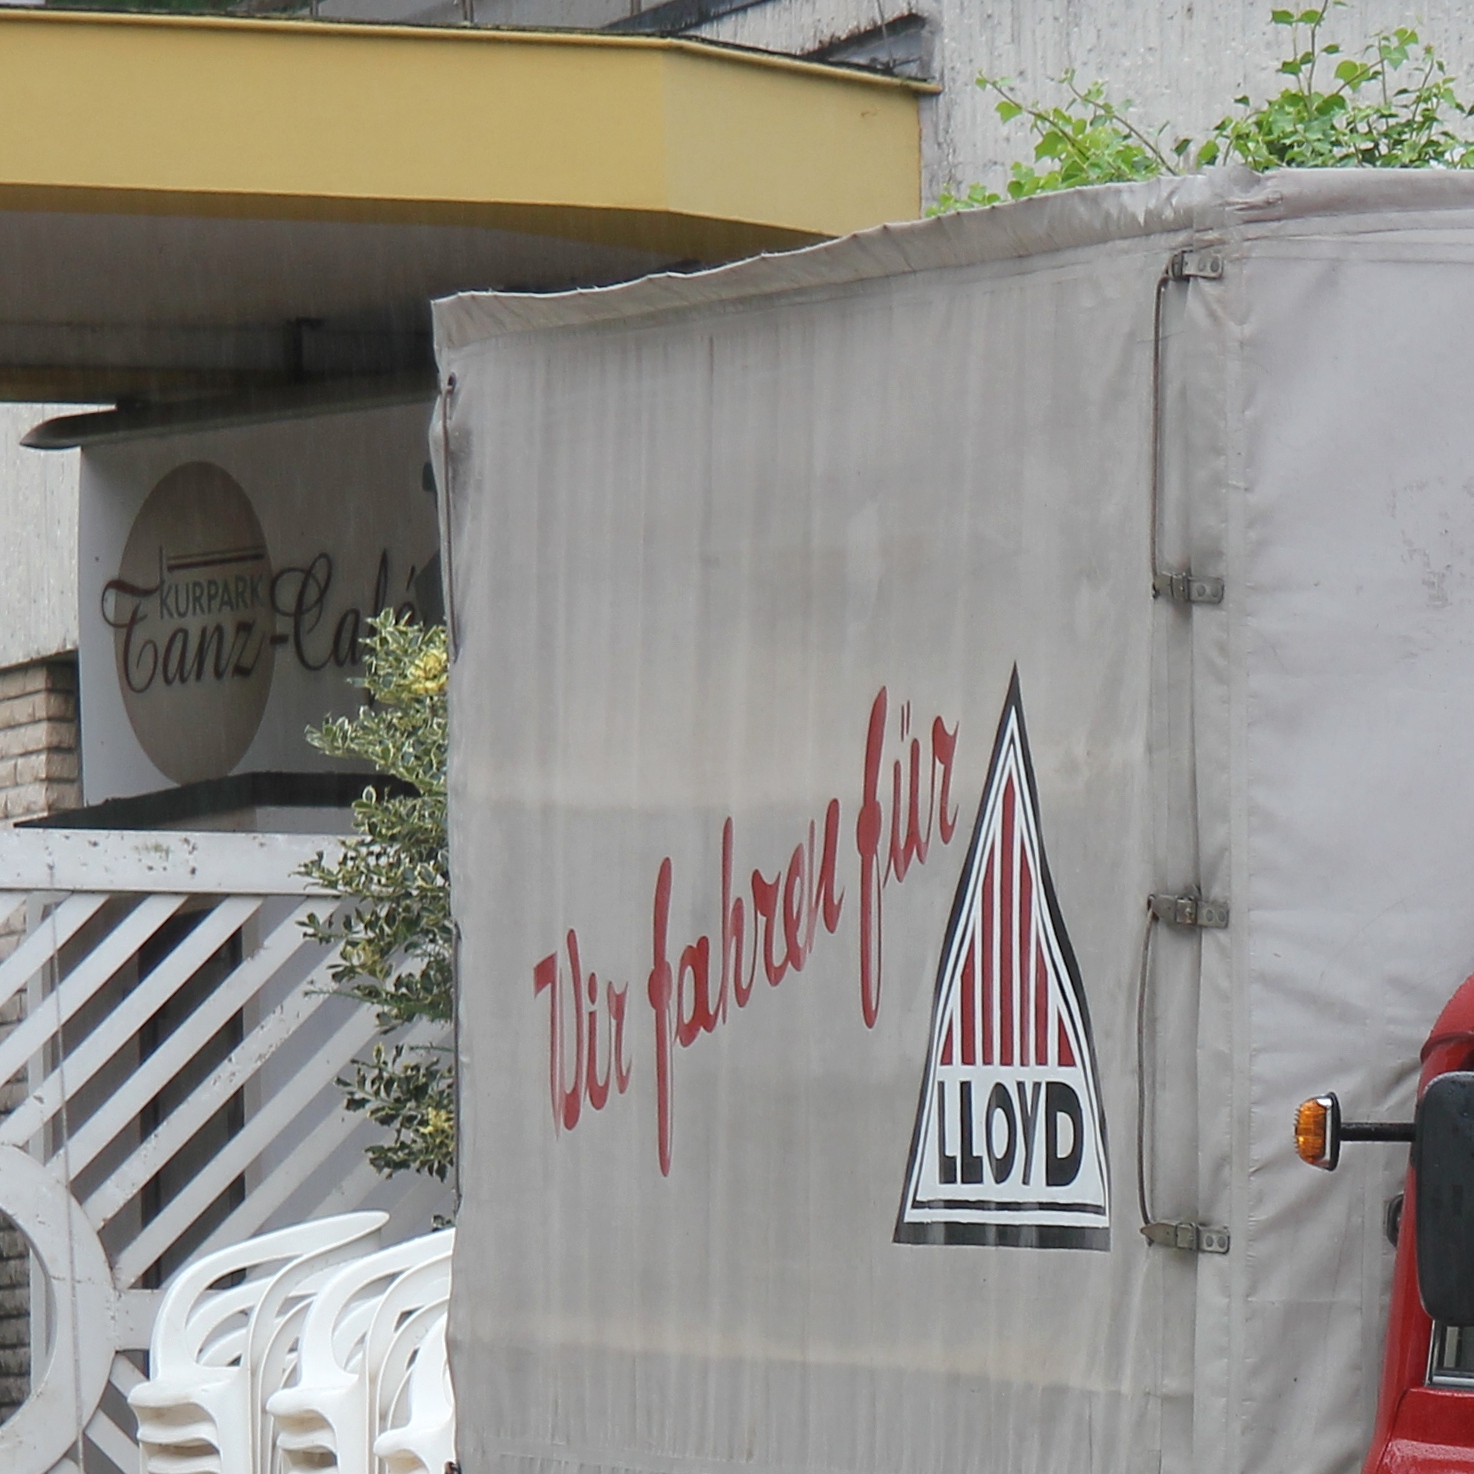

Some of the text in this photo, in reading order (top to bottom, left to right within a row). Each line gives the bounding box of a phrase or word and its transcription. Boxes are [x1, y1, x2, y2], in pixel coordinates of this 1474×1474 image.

[533, 685, 961, 1177] Wir fahren für
[937, 1080, 1085, 1188] LLOYD
